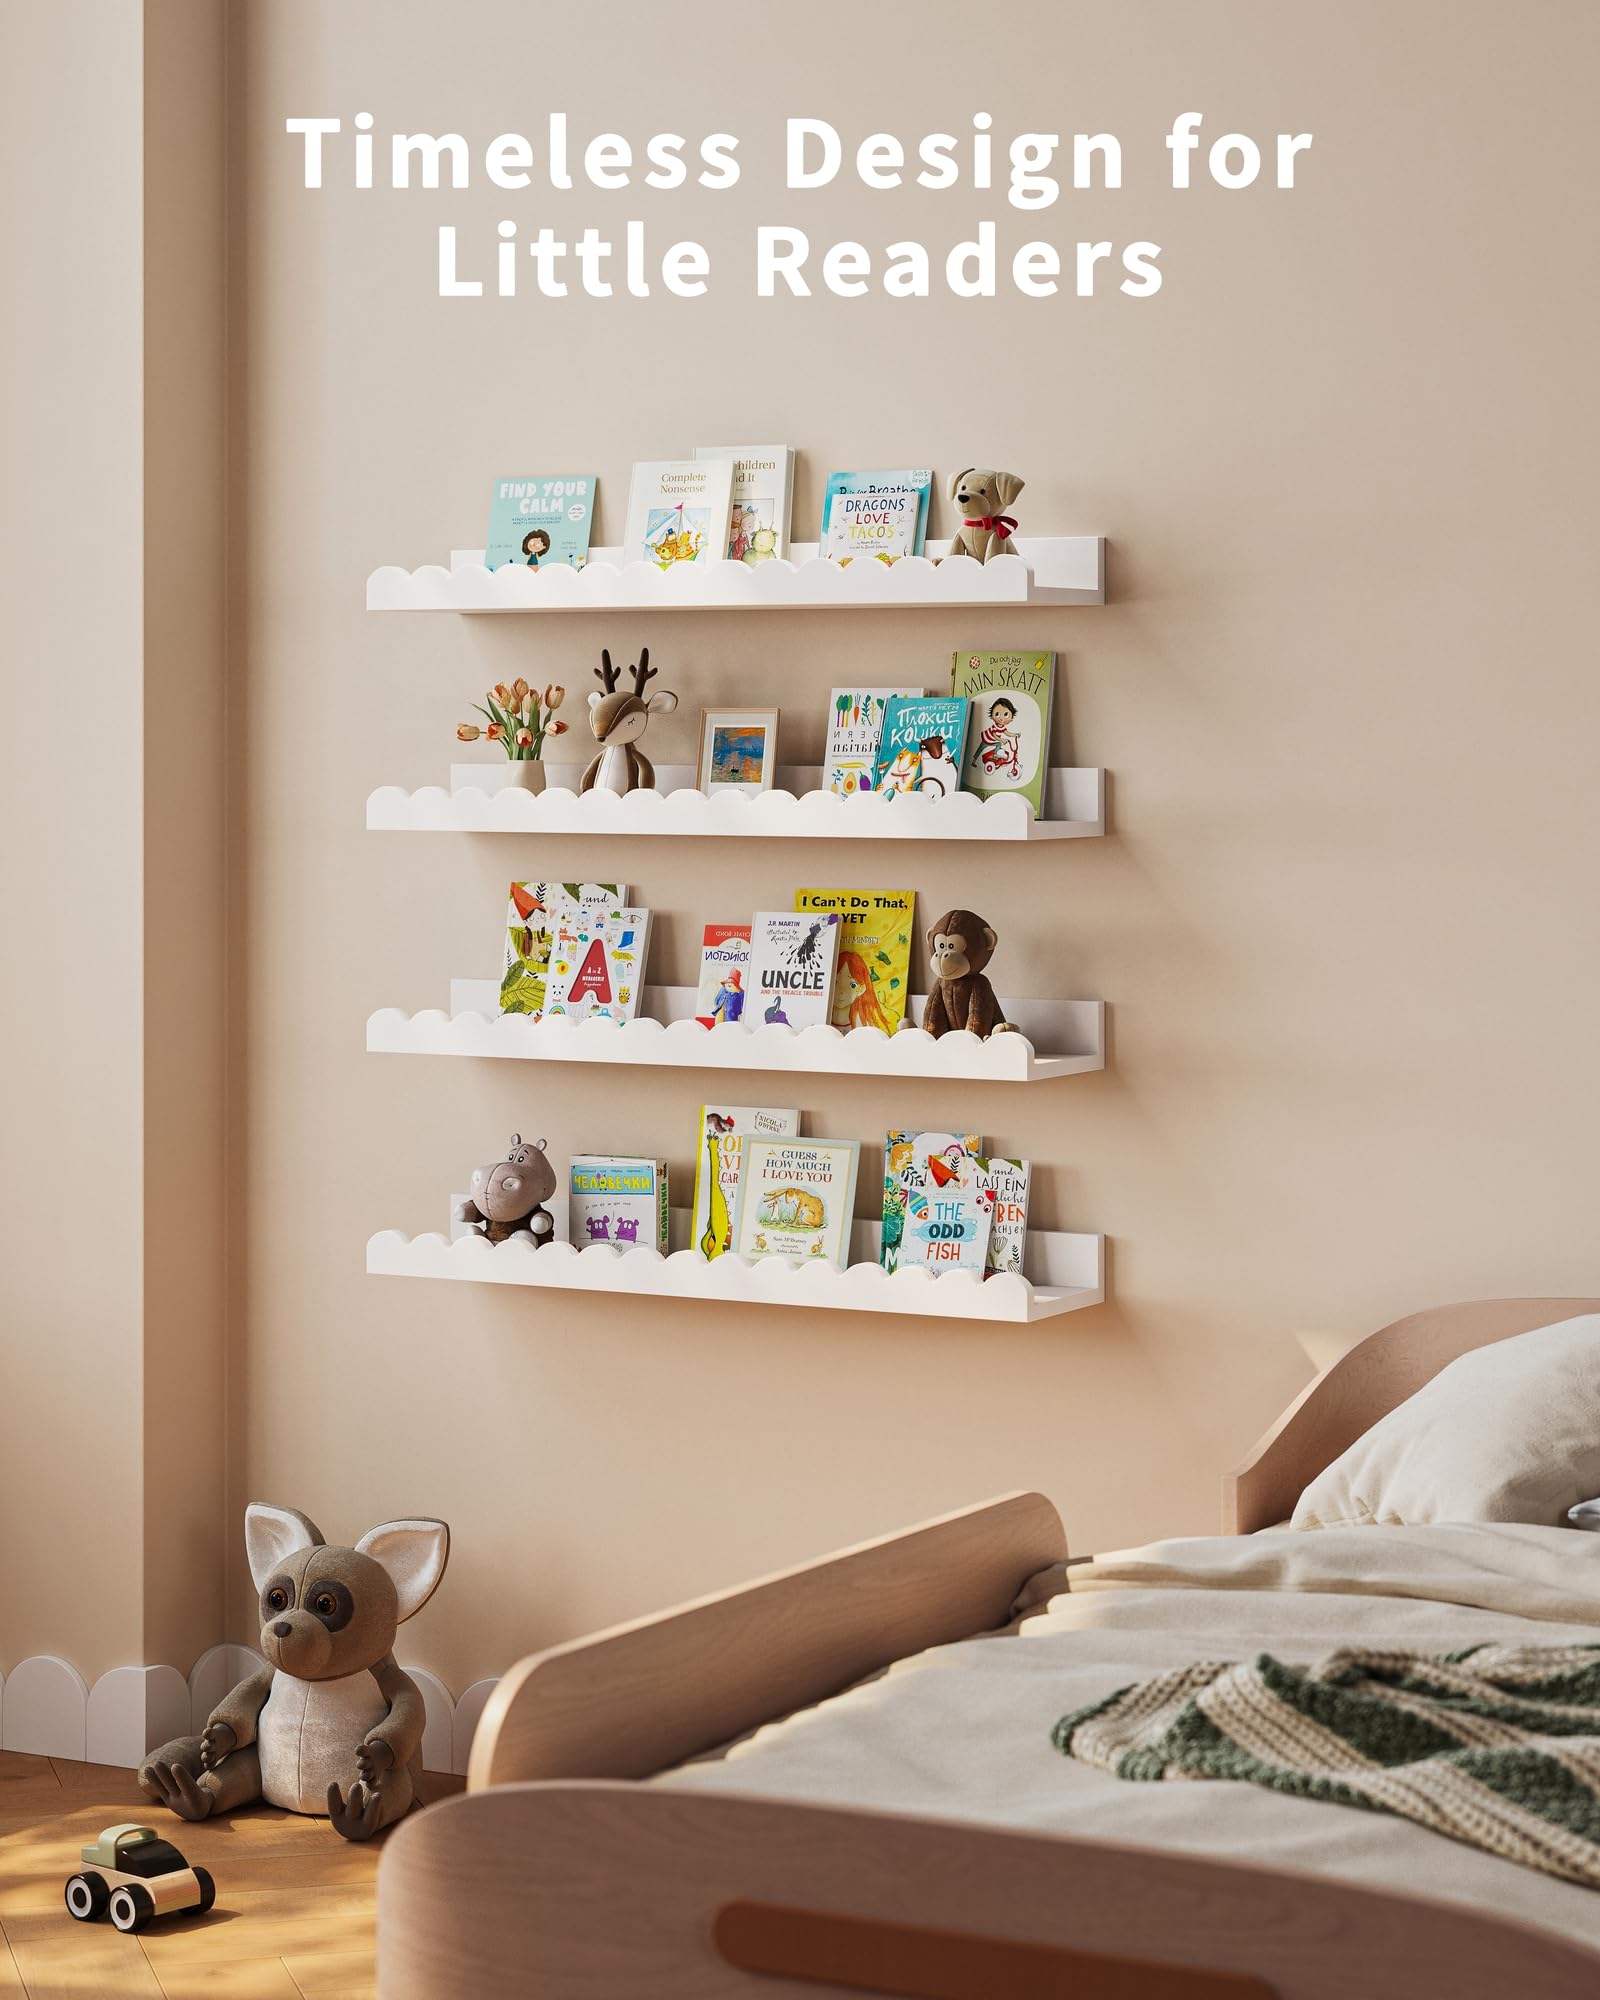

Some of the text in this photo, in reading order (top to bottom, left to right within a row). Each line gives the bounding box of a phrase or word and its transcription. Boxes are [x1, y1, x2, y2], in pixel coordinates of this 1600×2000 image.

[661, 473, 707, 485] Complete
[500, 481, 587, 499] FIND YOUR
[660, 484, 706, 495] Nonsense
[519, 498, 564, 514] CALM
[846, 498, 906, 513] DRAGONS
[856, 512, 890, 525] LOVE
[848, 525, 896, 540] TACOS
[990, 655, 1022, 667] Du och jag
[963, 666, 1046, 698] MIN SKATT
[584, 893, 610, 904] und
[803, 896, 908, 910] I Can’t Do That,
[779, 920, 801, 928] MARTIN
[841, 913, 867, 924] YET
[587, 966, 592, 974] A
[597, 966, 602, 974] Z
[761, 969, 825, 990] UNCLE
[758, 1114, 783, 1129] NICOLA
[781, 1150, 817, 1161] GUESS
[766, 1159, 831, 1172] HOW MUCH
[992, 1167, 1015, 1176] und
[573, 1175, 651, 1191] ЧЕЛОВЕЧКИ
[762, 1169, 833, 1183] I LOVE YOU
[976, 1175, 1000, 1190] LASS
[935, 1202, 966, 1221] THE
[928, 1222, 965, 1239] ODD
[926, 1241, 961, 1261] FISH
